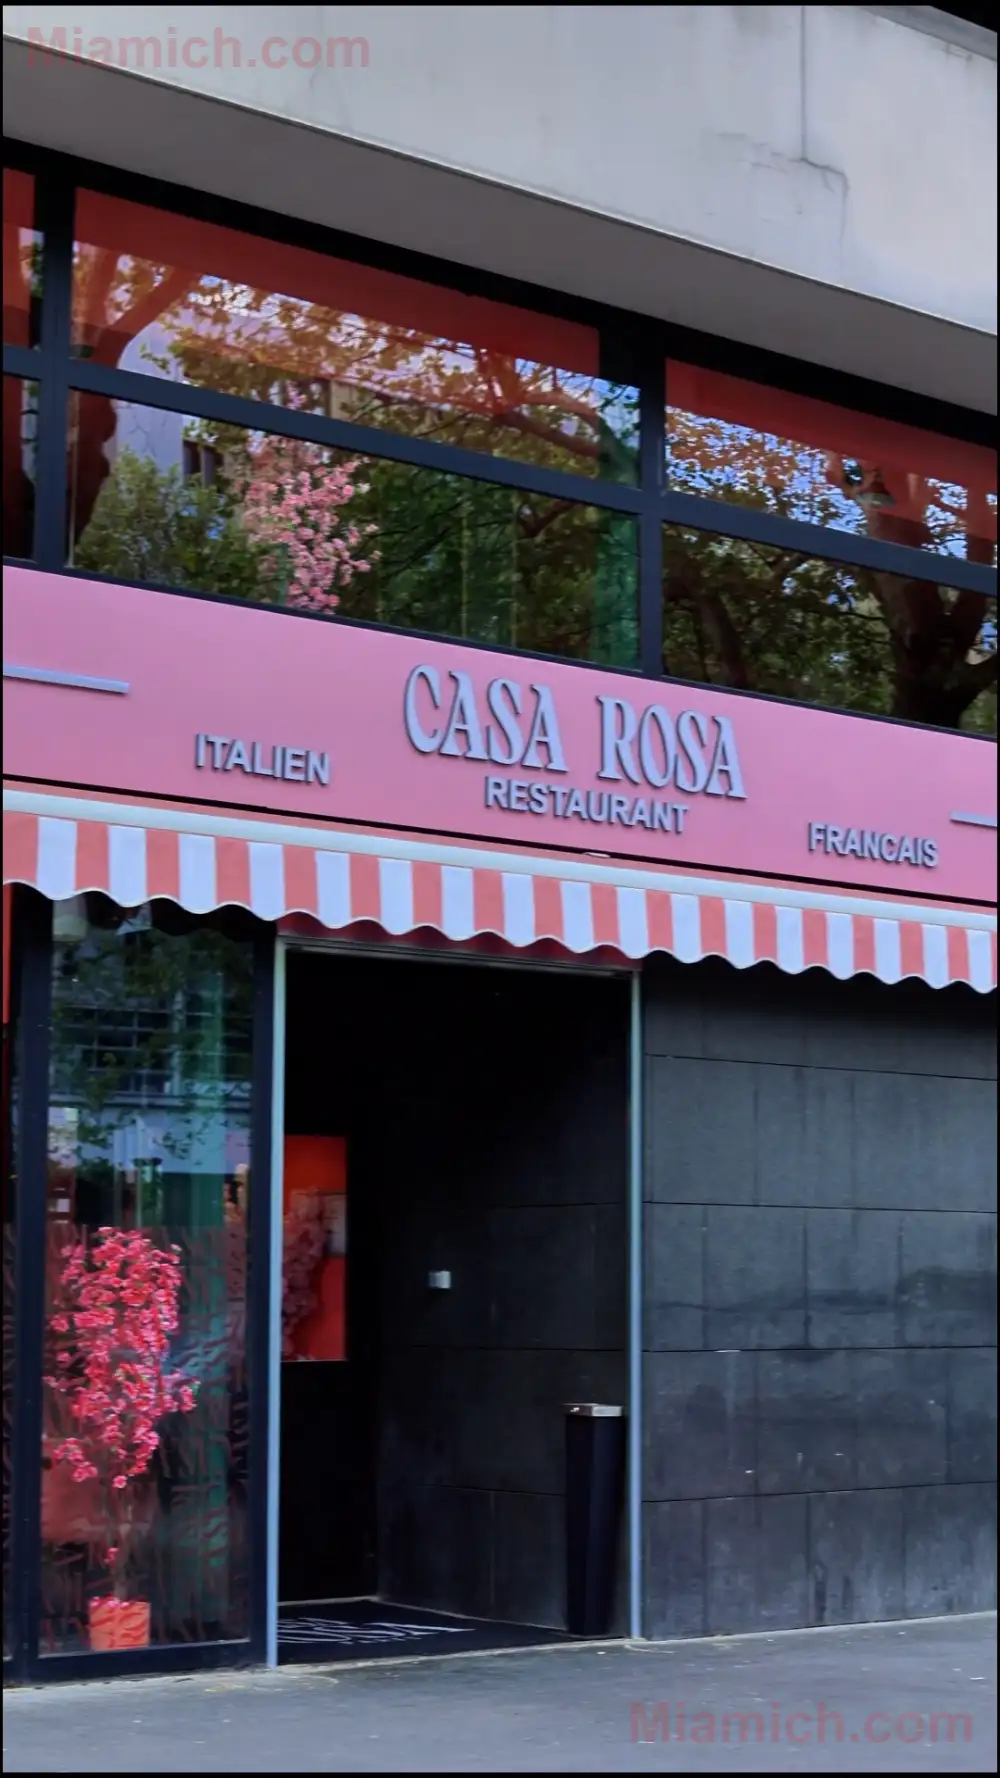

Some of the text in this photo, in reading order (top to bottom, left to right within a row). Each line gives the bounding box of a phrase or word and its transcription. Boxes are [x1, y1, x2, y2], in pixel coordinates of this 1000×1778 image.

[195, 733, 331, 786] ITALIEN
[404, 664, 748, 801] CASA ROSA
[484, 776, 689, 834] RESTAURANT
[807, 821, 938, 868] FRANCAIS
